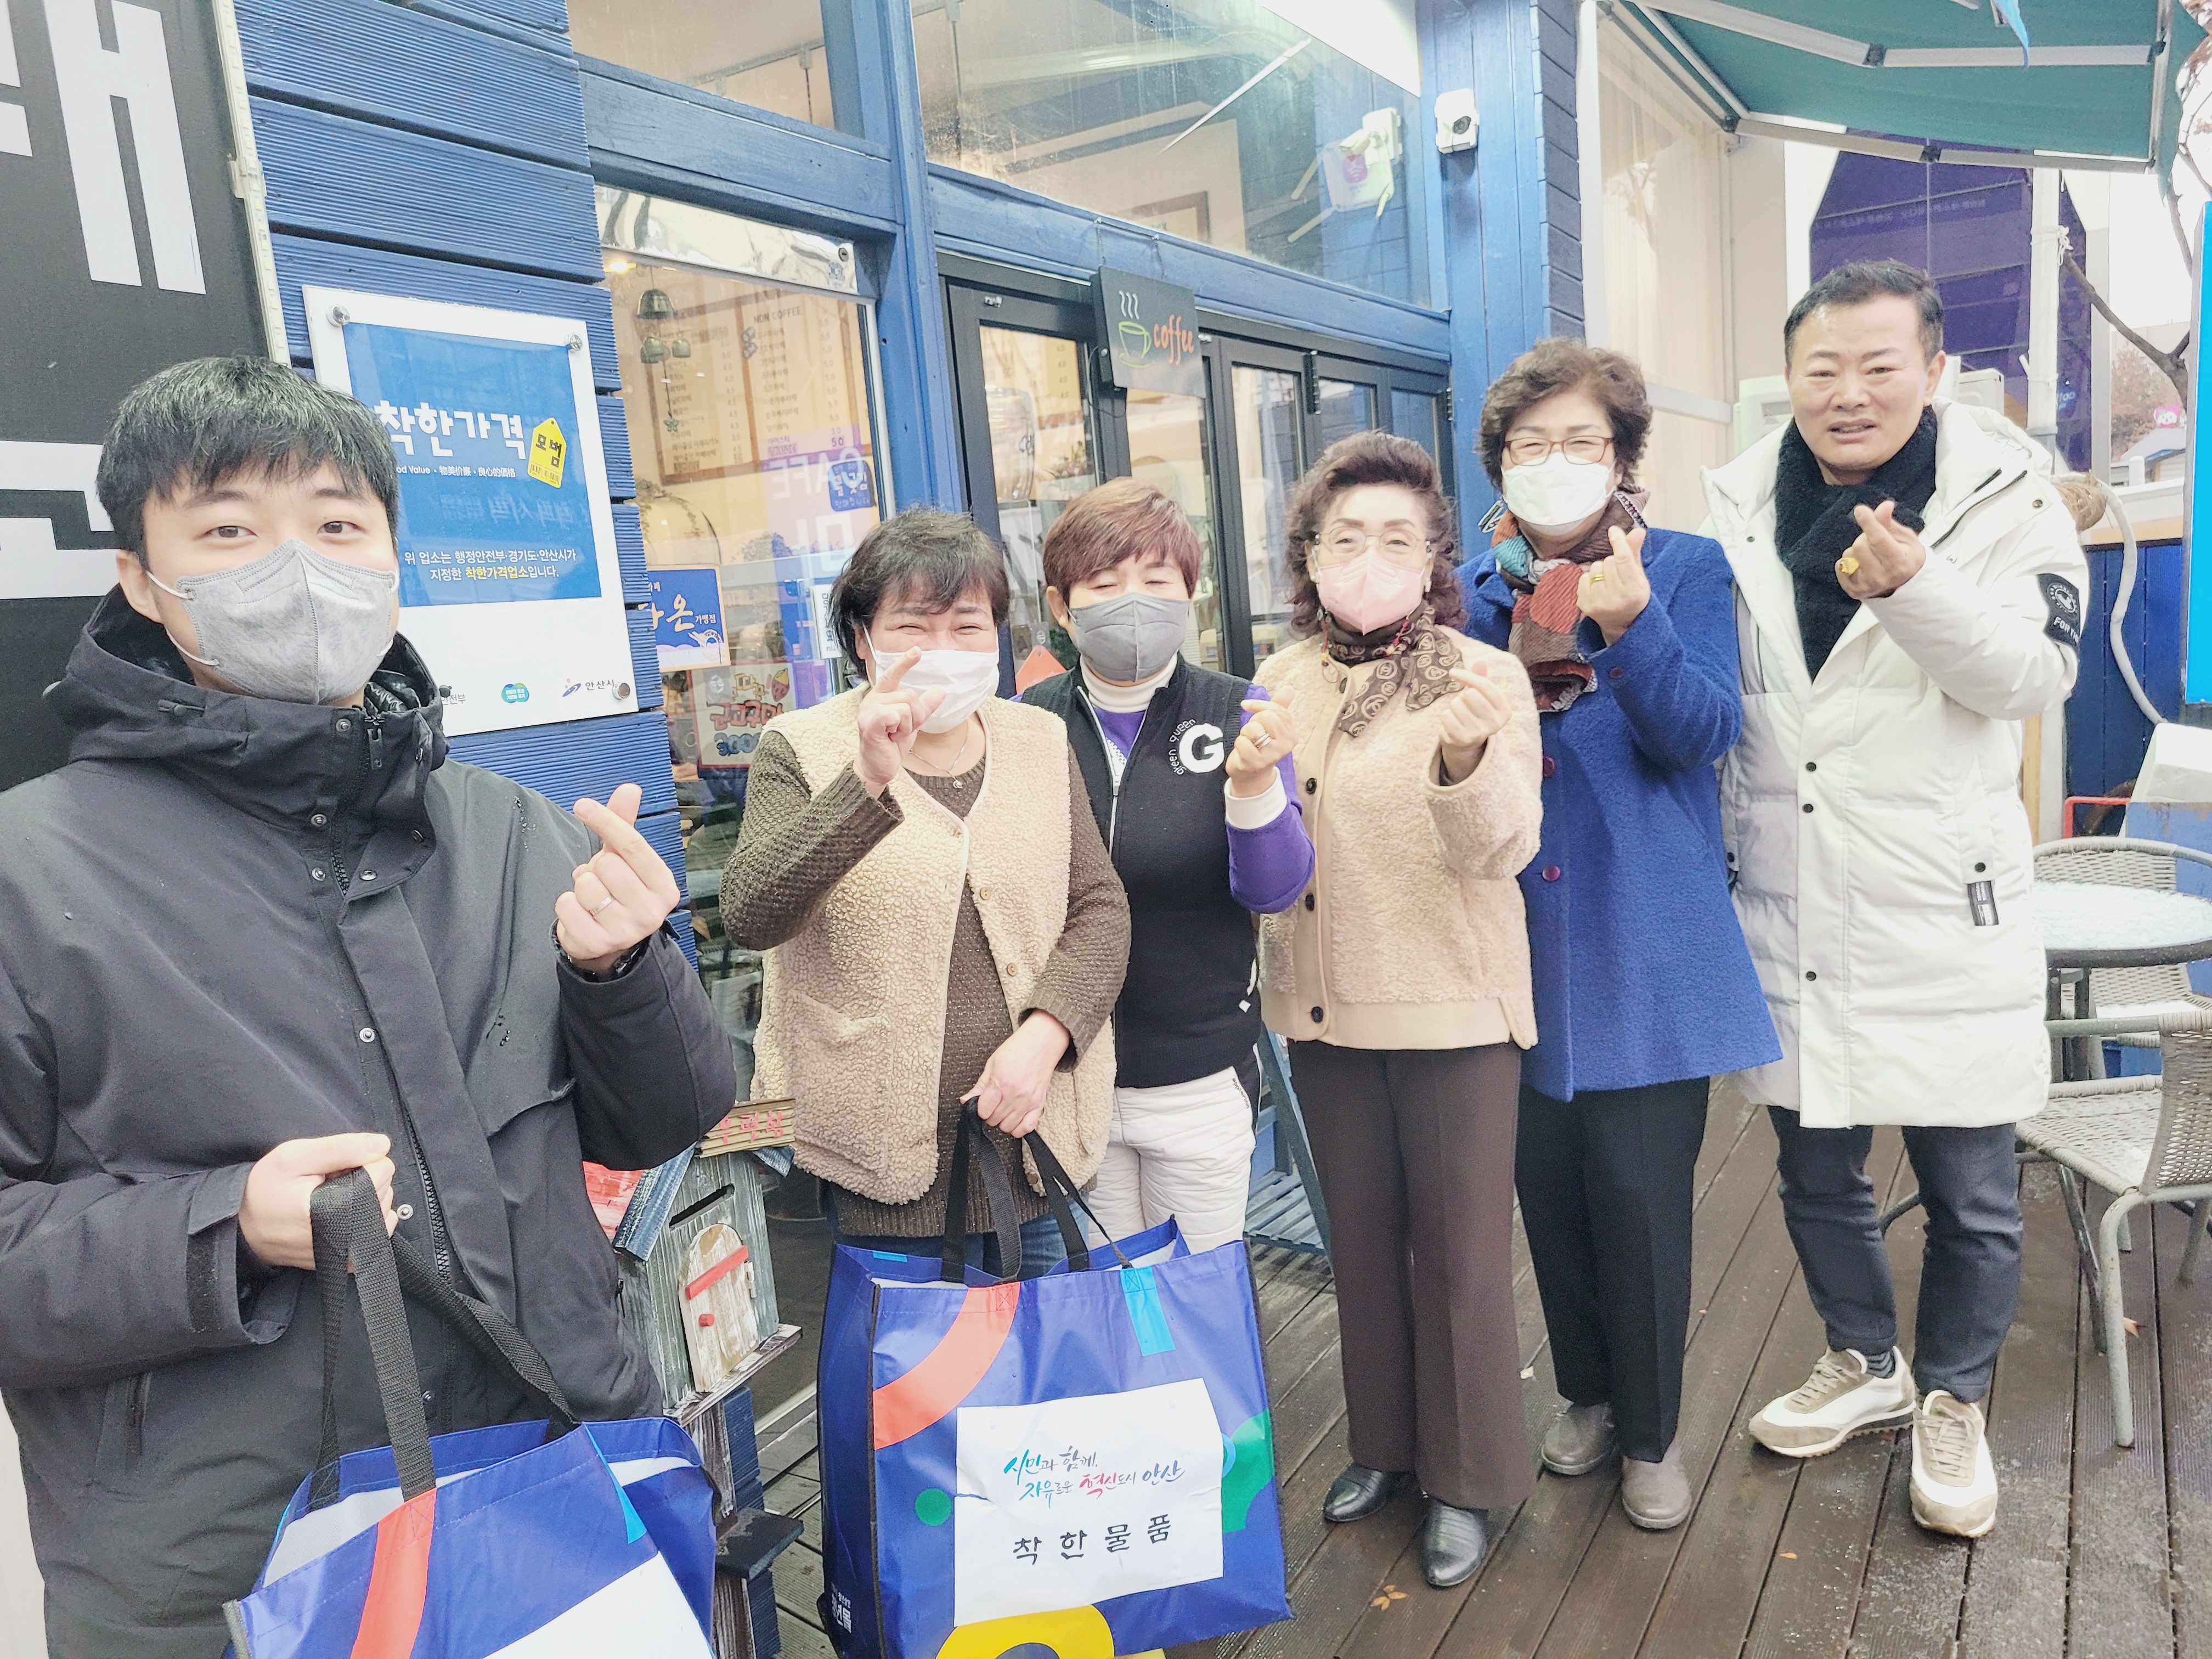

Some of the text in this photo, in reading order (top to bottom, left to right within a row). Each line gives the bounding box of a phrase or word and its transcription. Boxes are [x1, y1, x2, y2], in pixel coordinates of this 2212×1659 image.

[754, 307, 802, 324] NON COFFEE
[1154, 314, 1194, 366] coffee
[374, 400, 526, 460] 착한가격
[535, 433, 562, 469] 모범
[396, 465, 407, 474] od
[408, 465, 431, 475] Value
[404, 551, 416, 565] 위
[419, 551, 452, 565] 업소는
[430, 567, 462, 582] 지정한
[695, 613, 716, 624] 가맹점
[2053, 616, 2070, 634] FOR
[585, 679, 614, 691] 안산시
[1168, 719, 1196, 775] green queen
[1180, 723, 1224, 773] G
[1003, 1449, 1058, 1485] 시민과
[1019, 1460, 1186, 1508] 자유로운 혁신도시 안산
